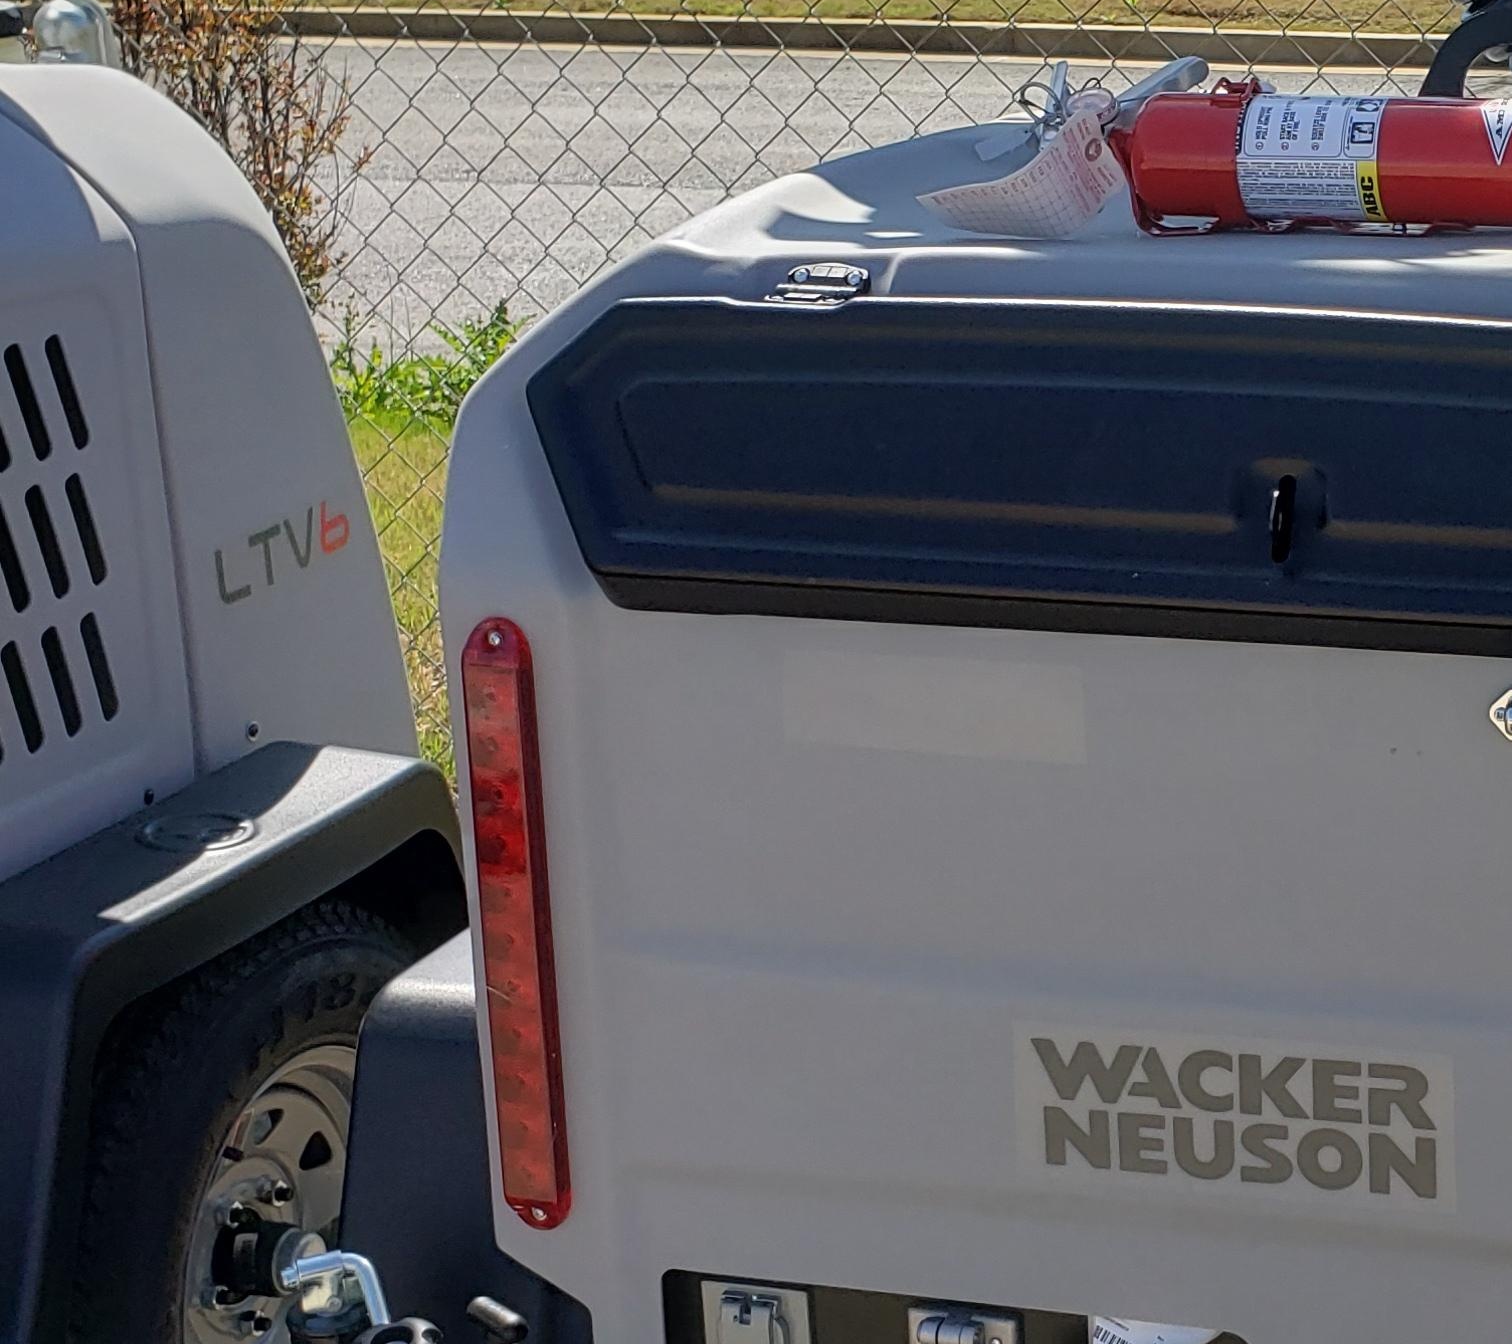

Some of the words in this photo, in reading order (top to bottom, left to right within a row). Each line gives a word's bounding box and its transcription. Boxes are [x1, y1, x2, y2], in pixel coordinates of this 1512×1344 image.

[1361, 176, 1381, 217] ABC
[213, 500, 351, 606] LTV6
[1030, 1037, 1437, 1131] WACKER
[1043, 1105, 1438, 1199] NEUSON
